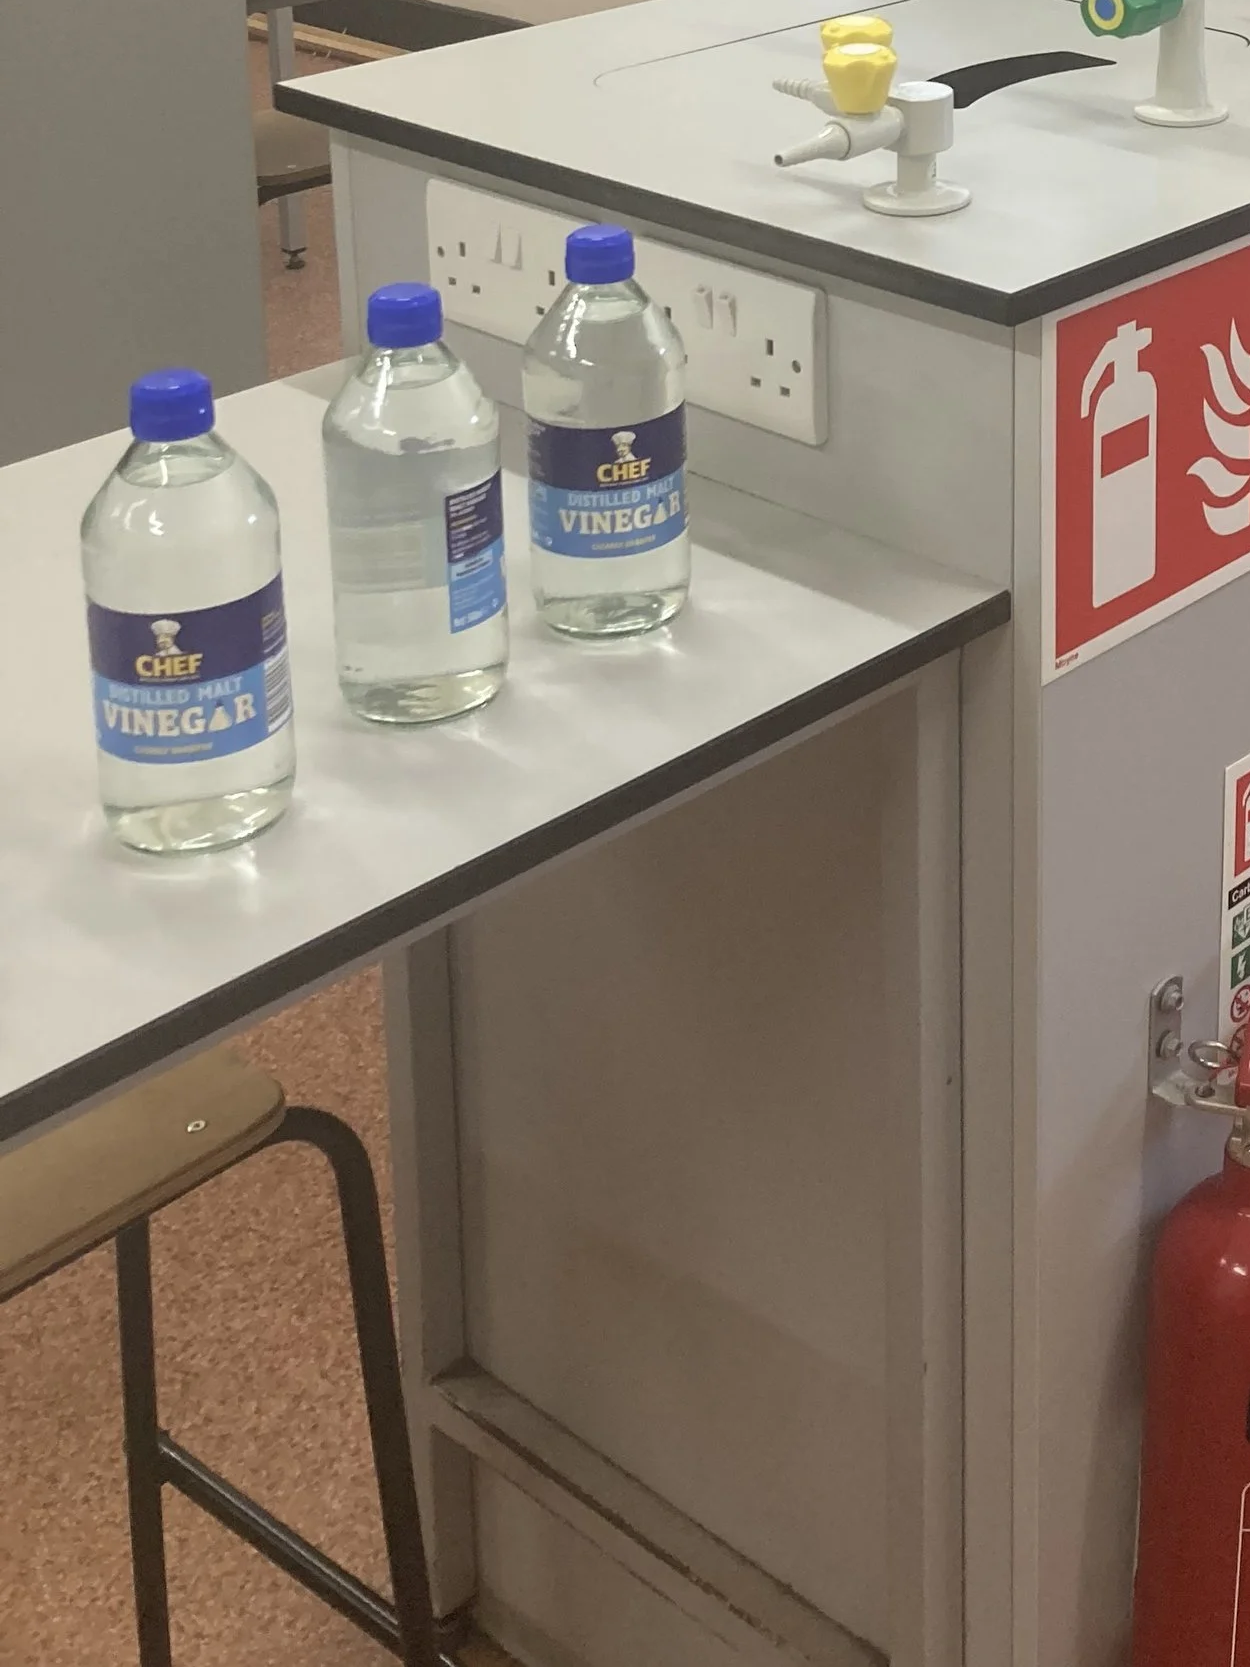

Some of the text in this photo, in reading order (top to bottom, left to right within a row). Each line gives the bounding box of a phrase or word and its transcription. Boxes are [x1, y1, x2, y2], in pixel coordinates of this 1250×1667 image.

[596, 457, 651, 483] CHEF
[567, 477, 674, 508] DISTILLED MALT
[559, 490, 681, 535] VINEGAR
[135, 653, 204, 677] CHEF
[197, 676, 243, 700] MALT
[102, 693, 257, 737] VINEGAR
